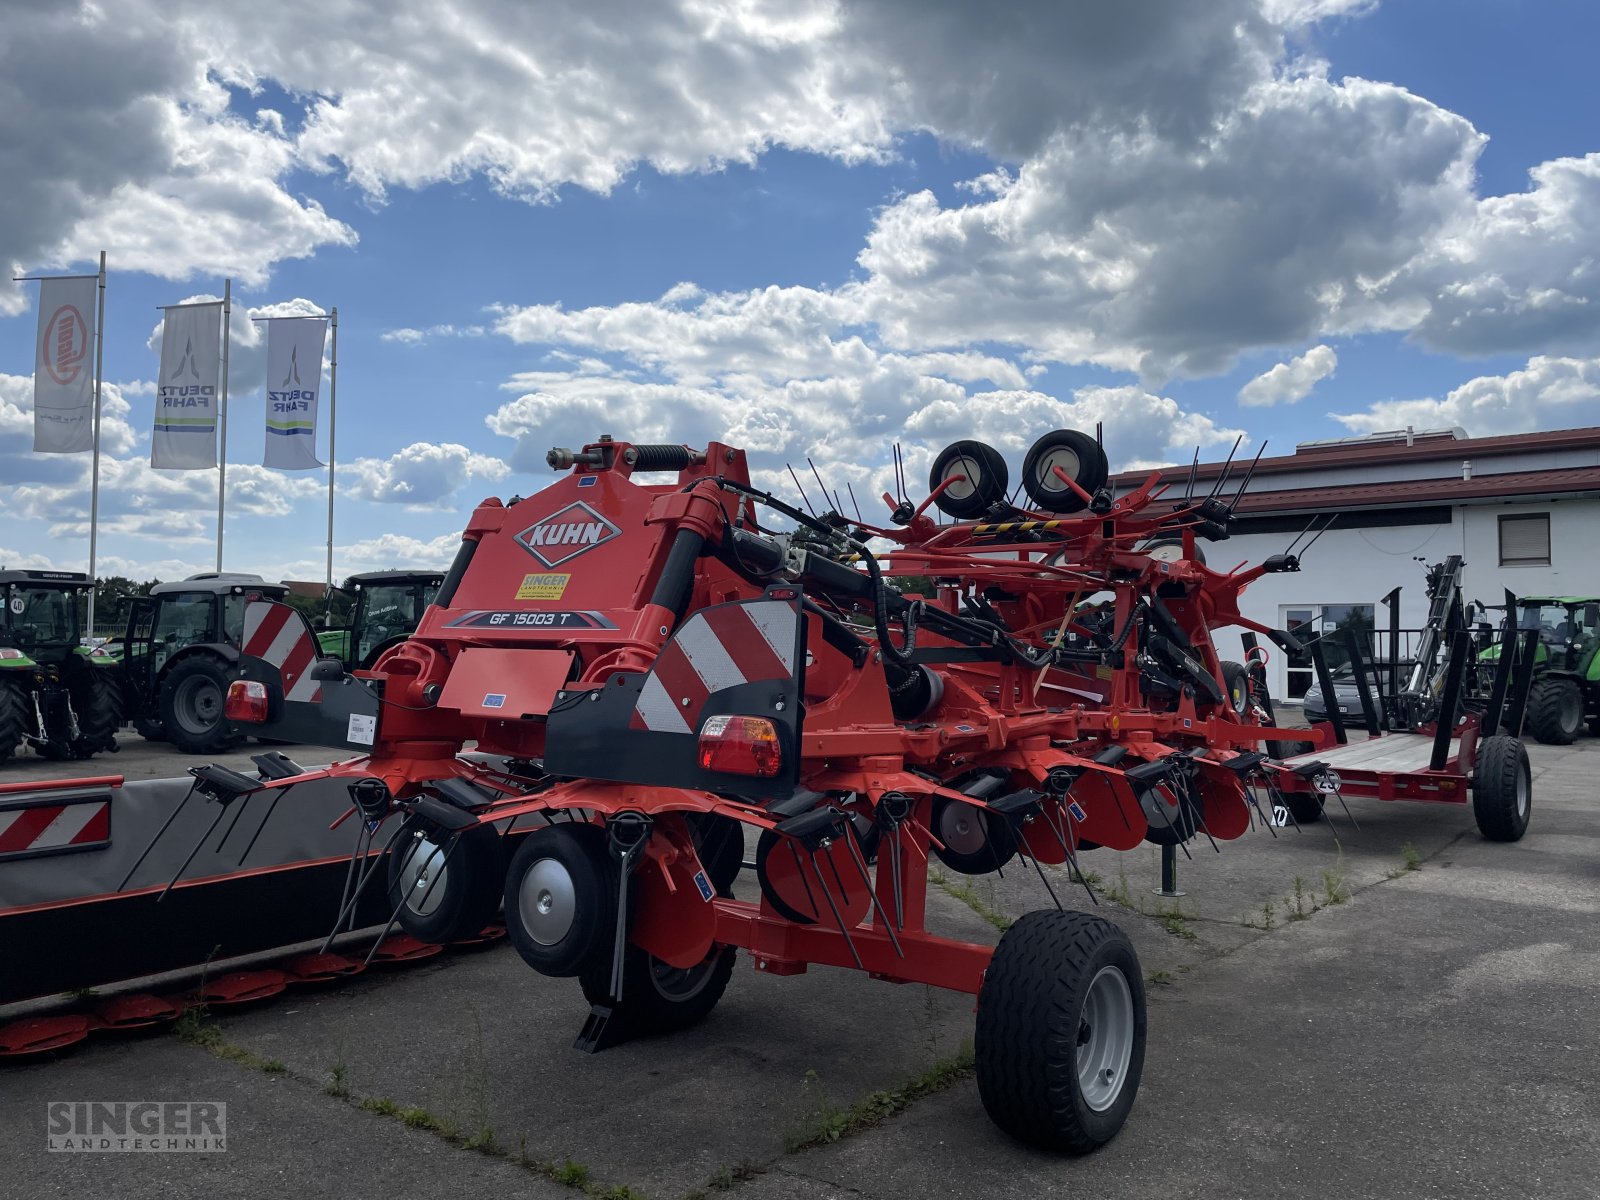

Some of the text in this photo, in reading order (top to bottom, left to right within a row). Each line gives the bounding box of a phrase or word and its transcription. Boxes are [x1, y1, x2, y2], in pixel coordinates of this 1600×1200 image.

[528, 522, 604, 547] KUHN
[523, 575, 567, 586] SINGER
[13, 600, 23, 611] 40
[489, 613, 571, 625] GF 15003 T
